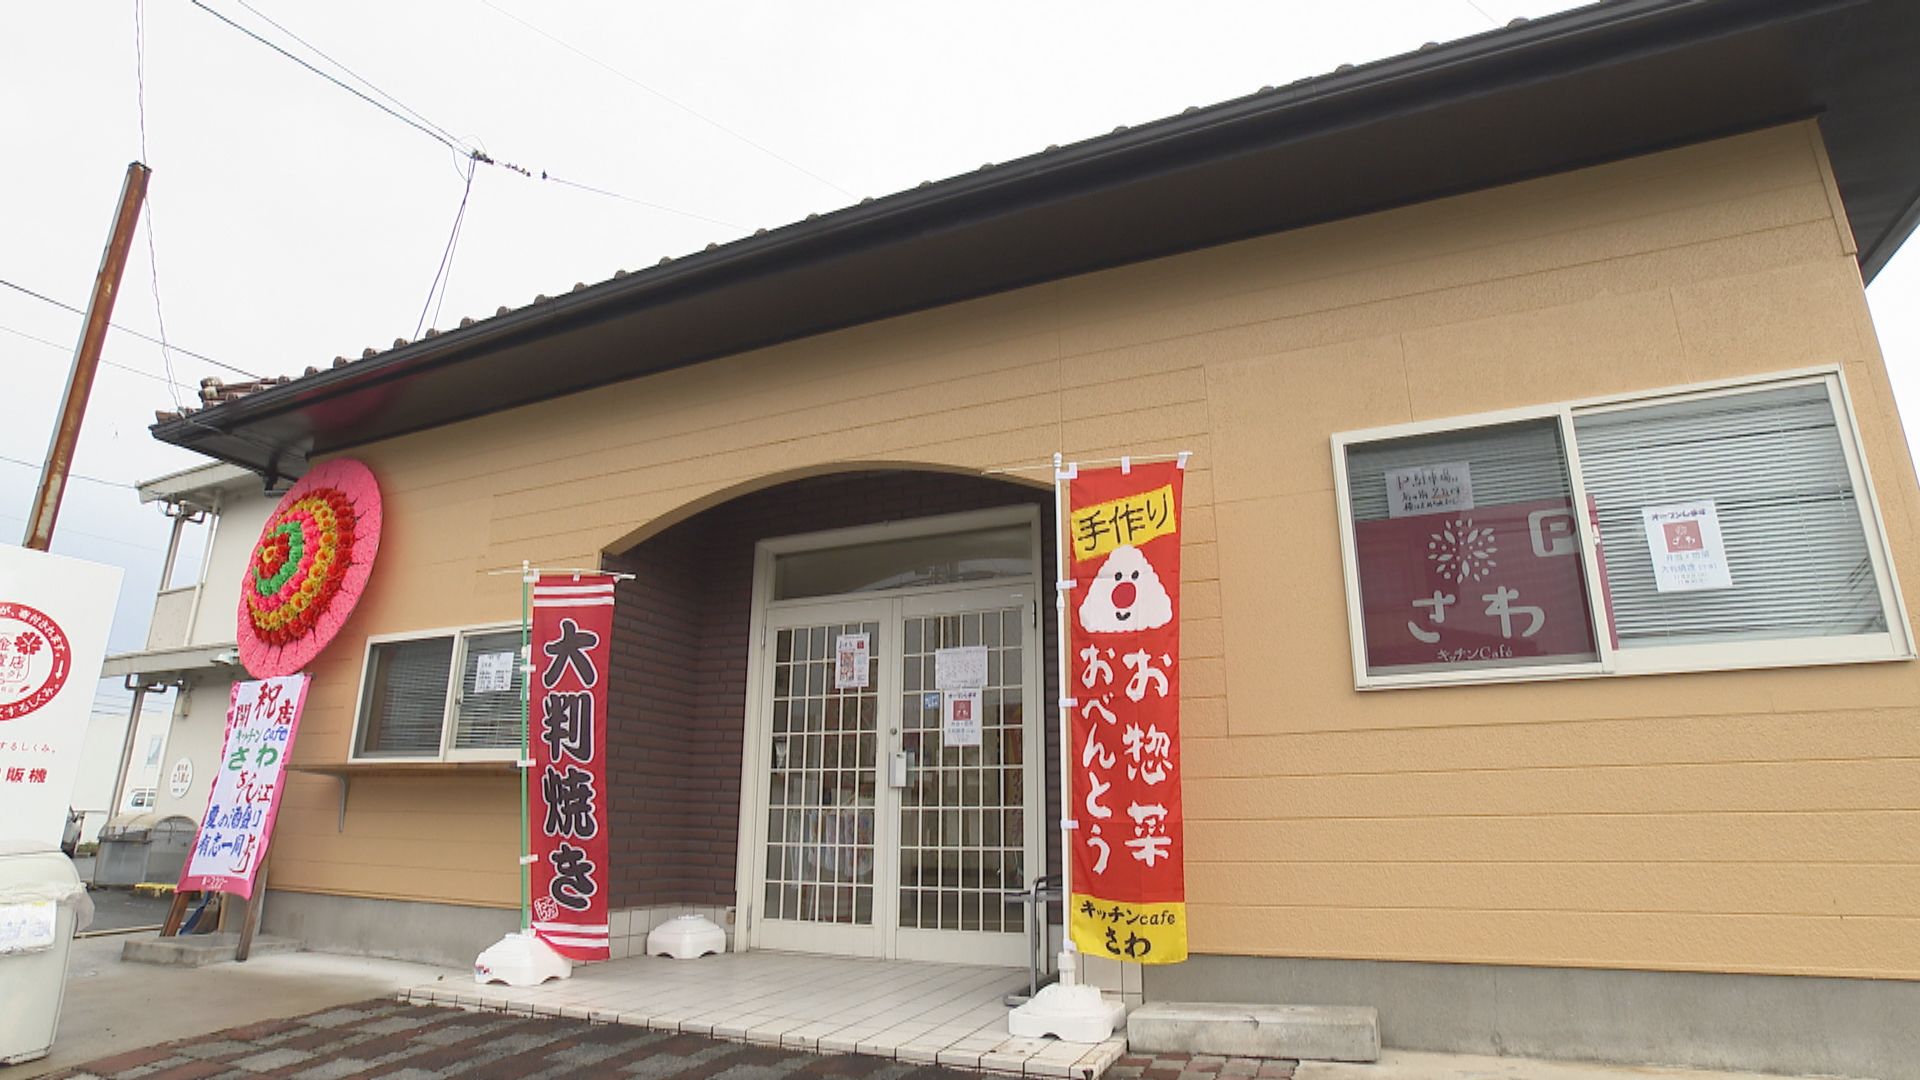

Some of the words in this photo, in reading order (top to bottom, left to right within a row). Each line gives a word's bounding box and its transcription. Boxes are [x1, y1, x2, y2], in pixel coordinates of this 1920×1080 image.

[1077, 493, 1169, 551] 手作り
[1407, 585, 1545, 643] さわ
[233, 699, 295, 729] 開店
[254, 682, 284, 721] 祝
[228, 743, 278, 771] さわ
[542, 618, 600, 911] 大判焼き
[1079, 643, 1118, 876] おべんとう
[1121, 648, 1174, 868] お惣菜
[1080, 900, 1176, 926] キッチンcafe
[1105, 926, 1152, 959] さわ
